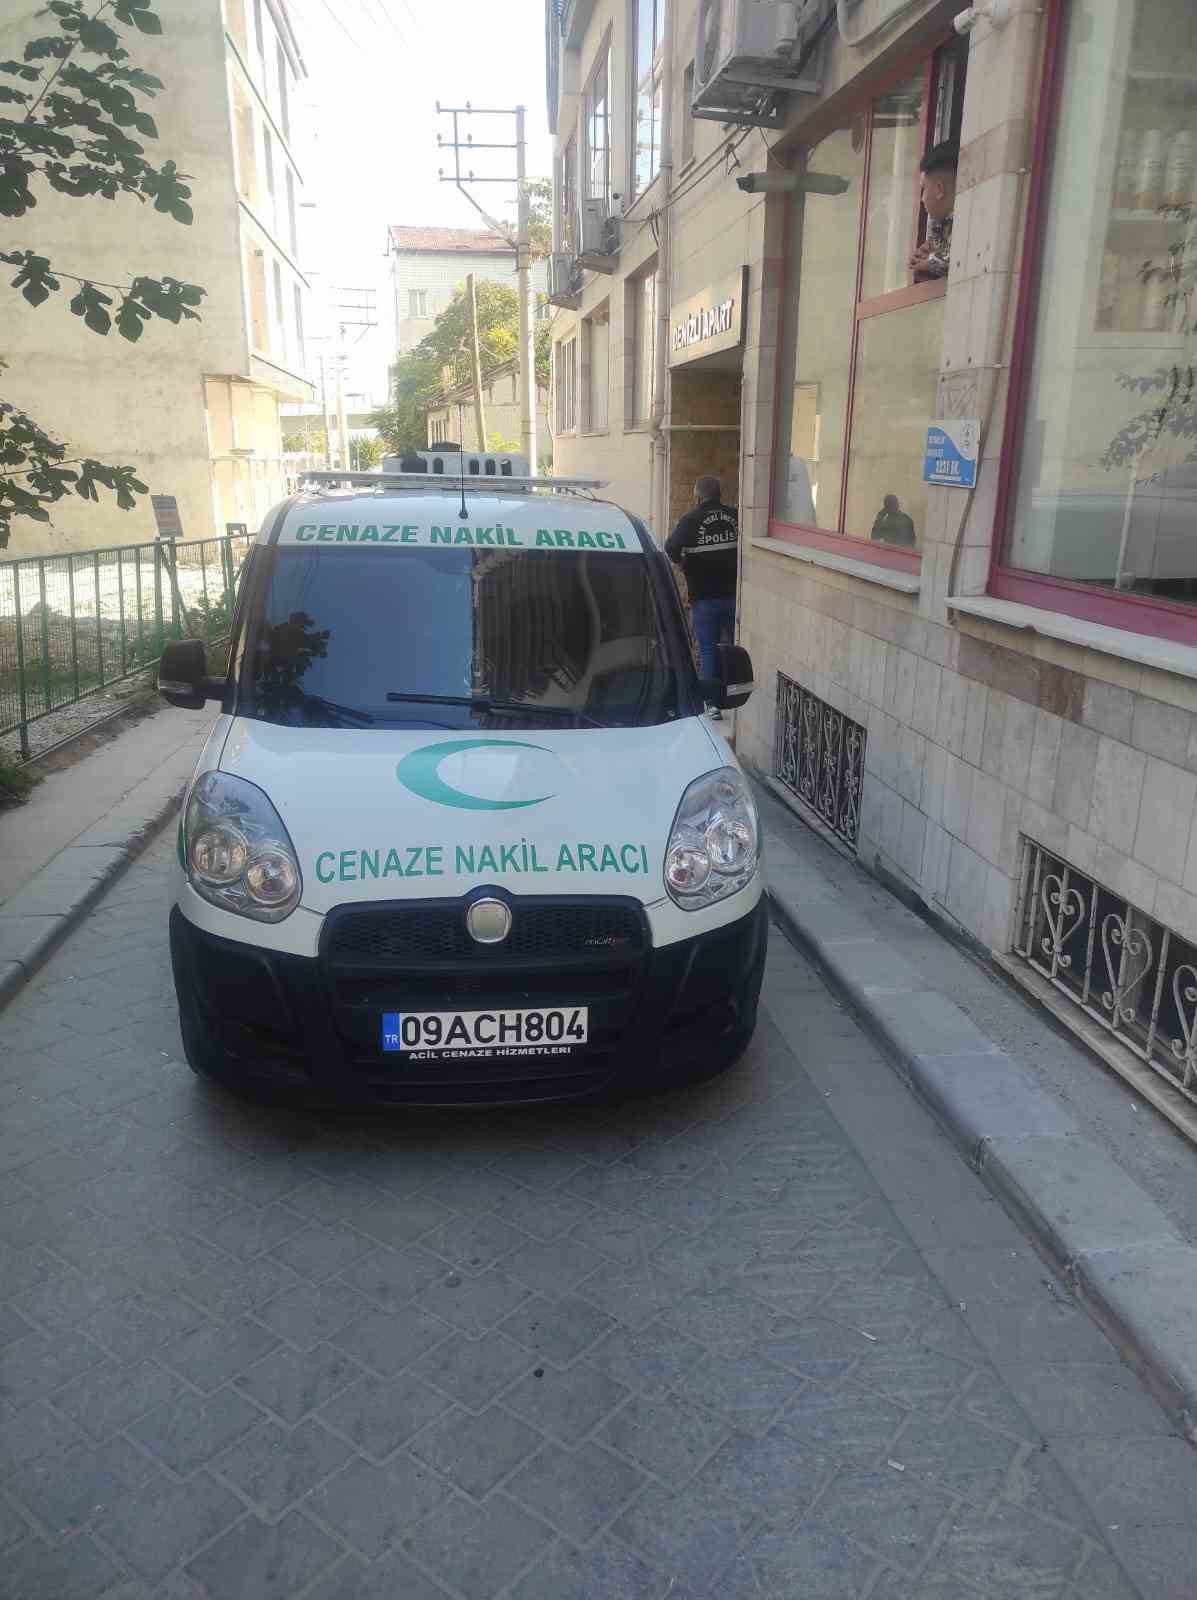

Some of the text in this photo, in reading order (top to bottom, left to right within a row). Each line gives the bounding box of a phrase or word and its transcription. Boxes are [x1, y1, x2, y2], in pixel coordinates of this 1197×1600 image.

[672, 298, 735, 352] DENİZLİ APART
[295, 523, 627, 549] CENAZE NAKİL ARACI
[705, 529, 737, 545] POLİS
[315, 838, 649, 883] CENAZE NAKİL ARACI
[384, 1034, 400, 1043] TR
[401, 1010, 585, 1047] 09ACH804
[409, 1048, 439, 1060] ACİL
[442, 1049, 493, 1059] CENAZE
